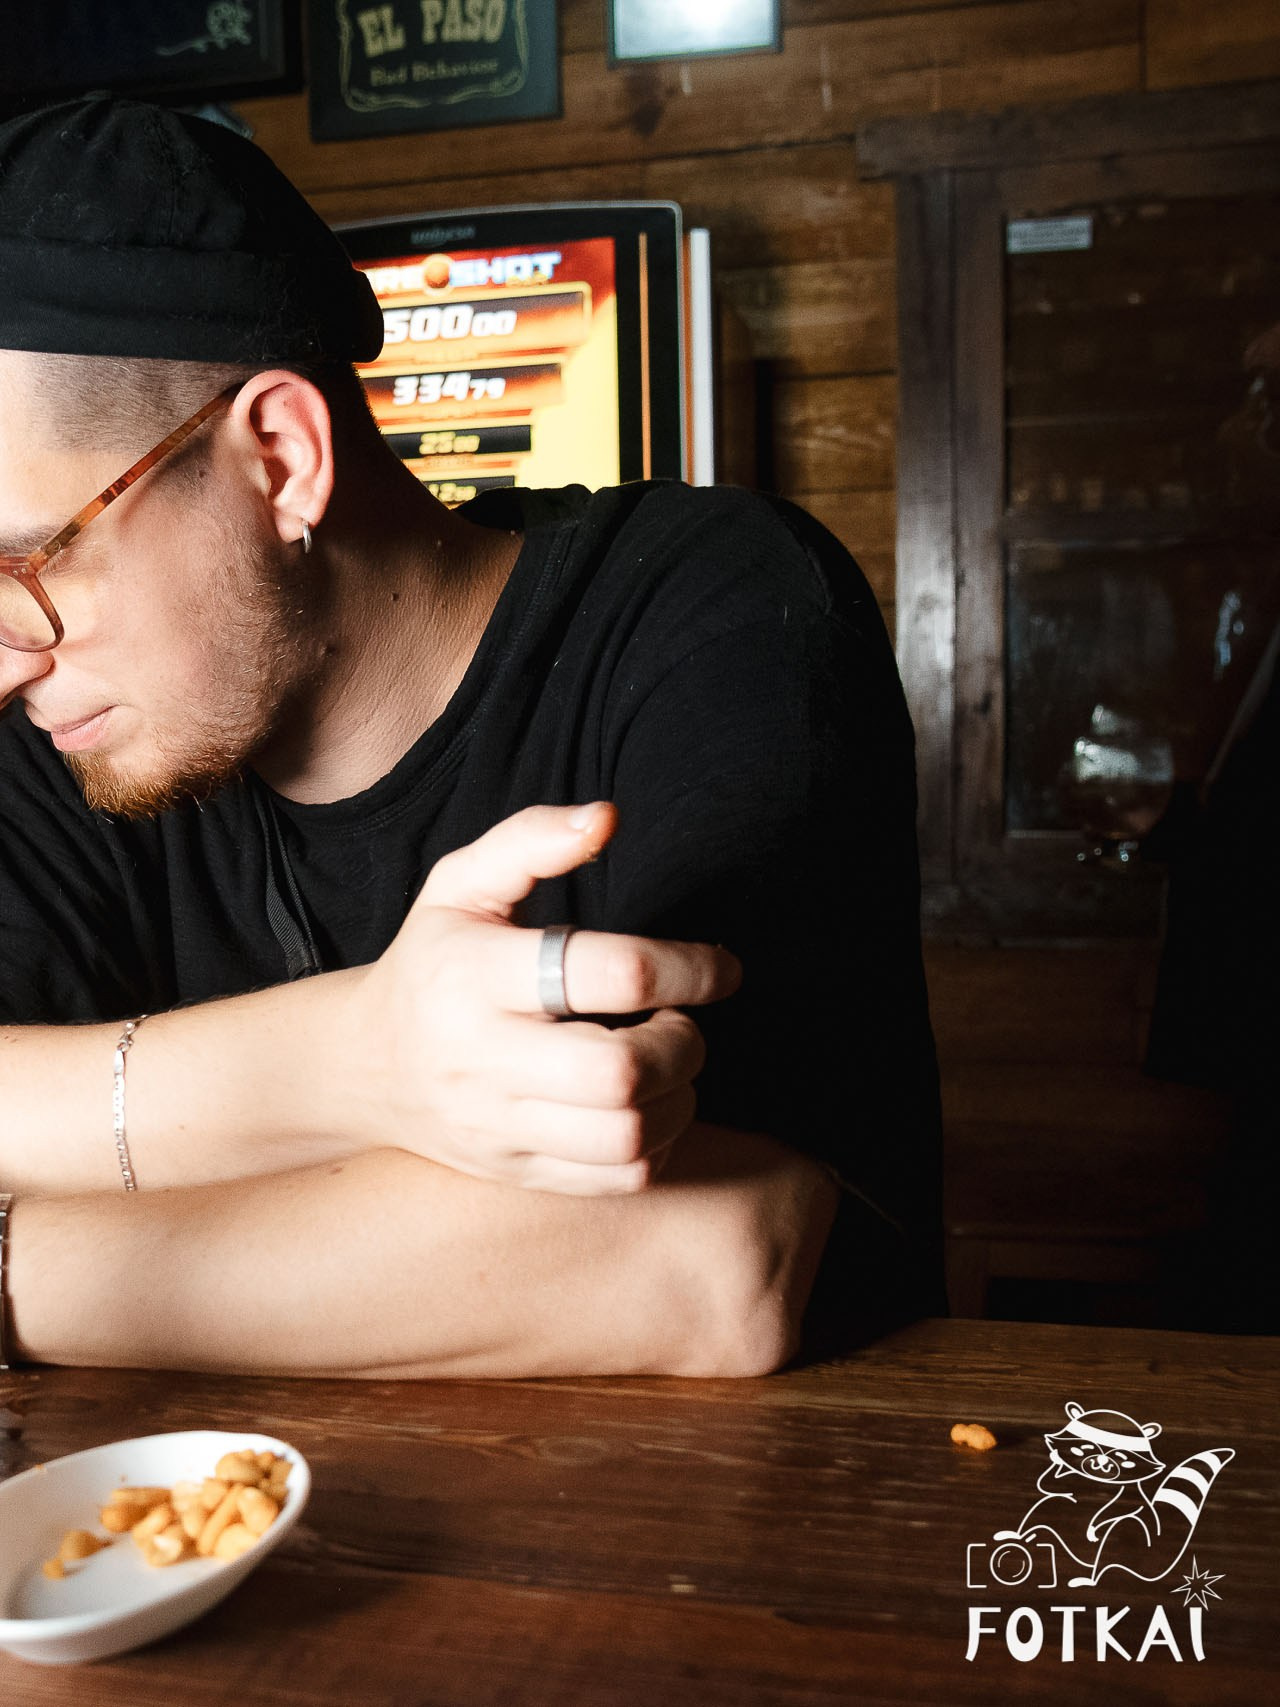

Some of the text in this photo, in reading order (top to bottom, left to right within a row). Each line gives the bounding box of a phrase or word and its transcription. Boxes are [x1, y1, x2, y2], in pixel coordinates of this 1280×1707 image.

[357, 0, 506, 57] EL PASO
[450, 252, 562, 286] SHOT
